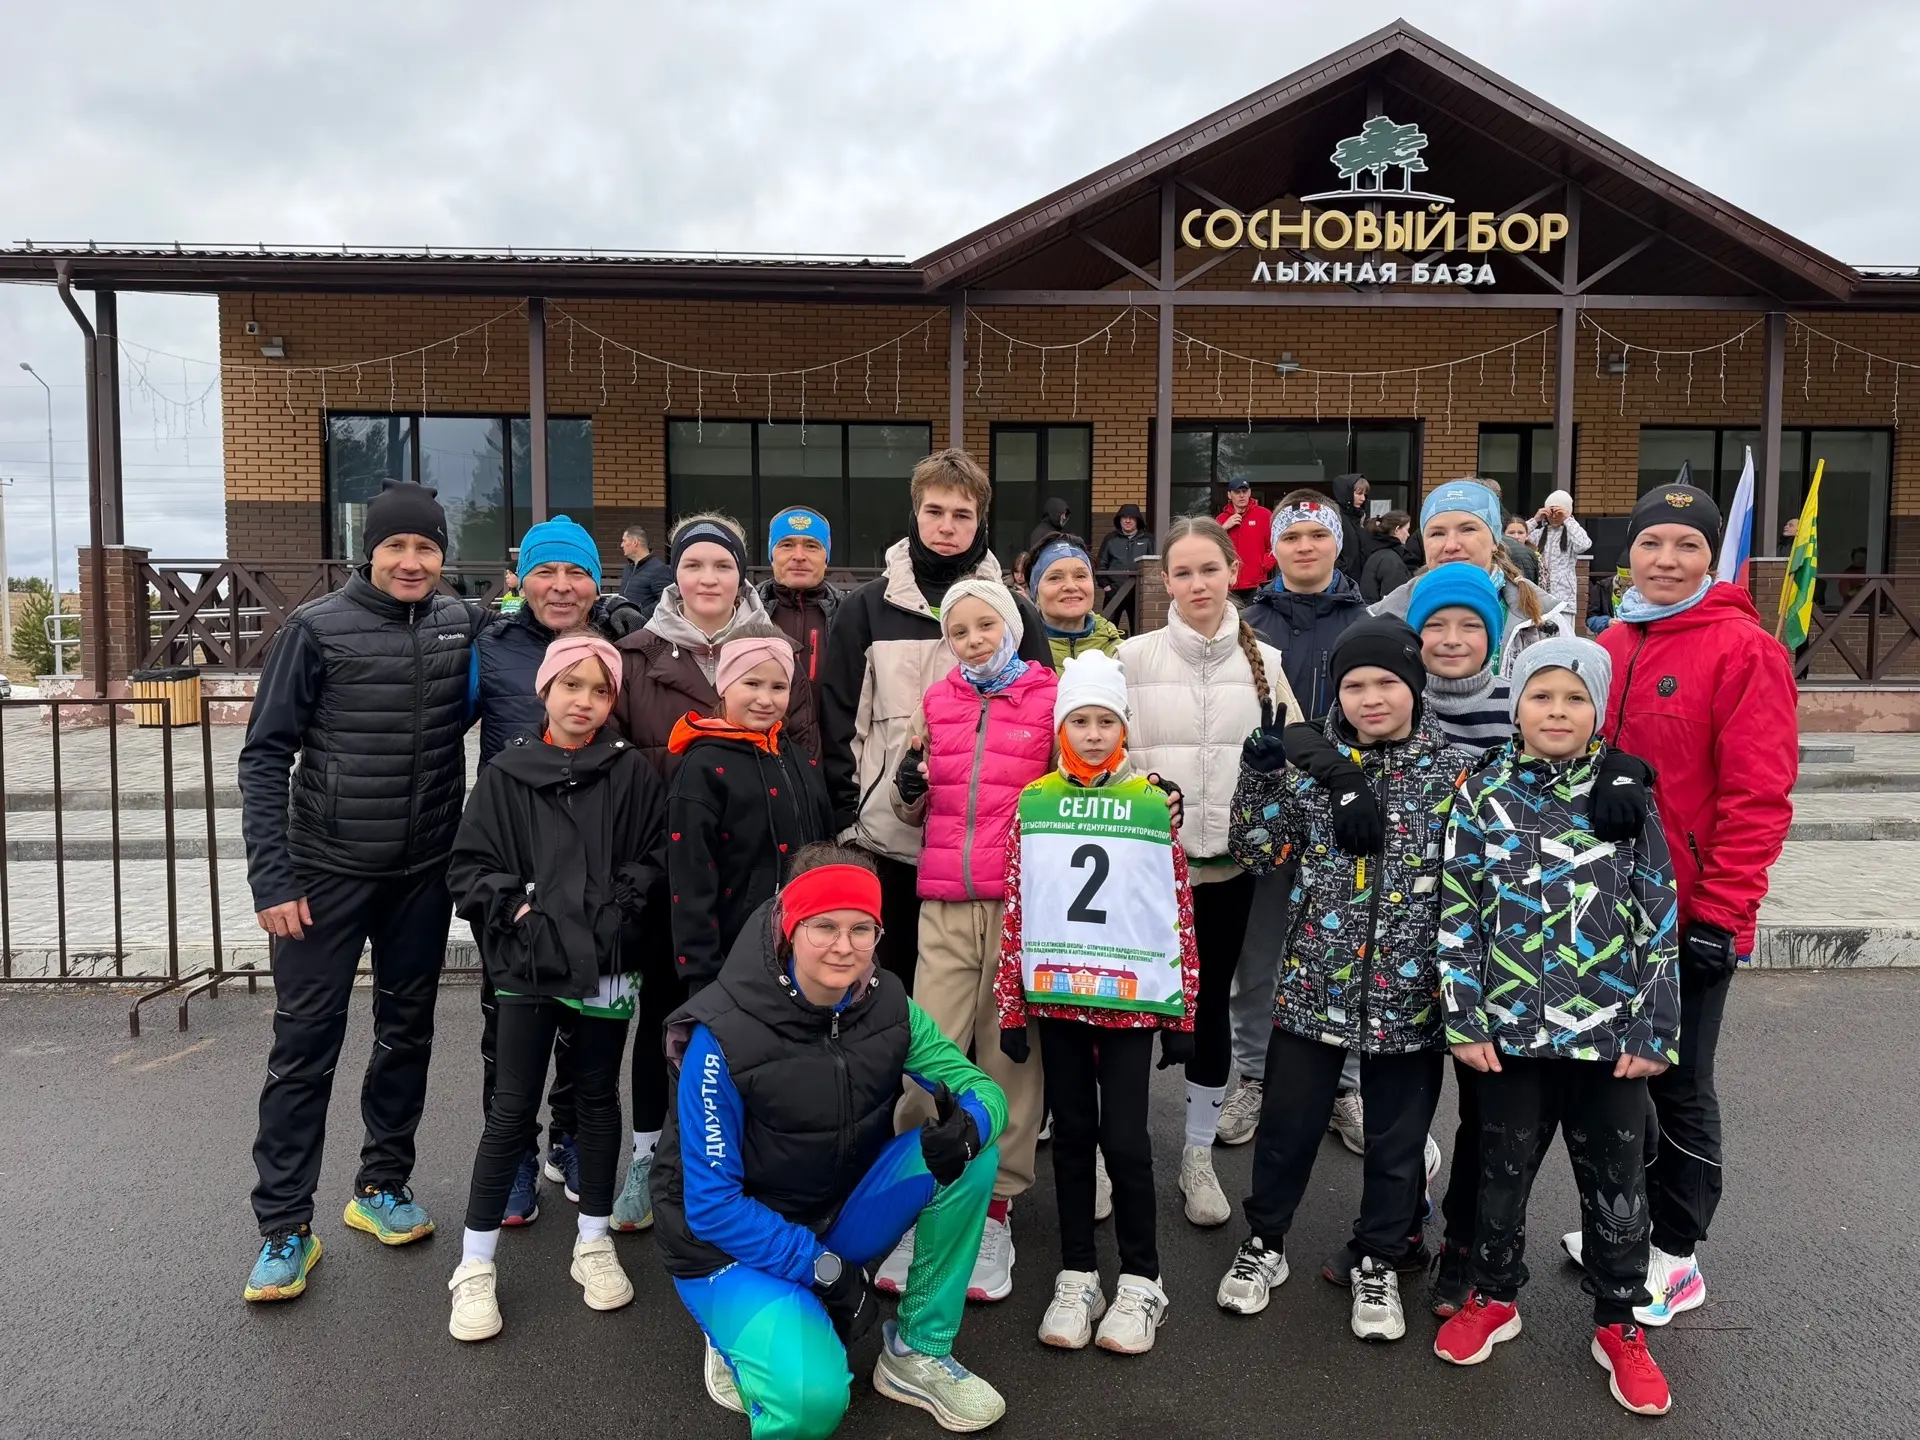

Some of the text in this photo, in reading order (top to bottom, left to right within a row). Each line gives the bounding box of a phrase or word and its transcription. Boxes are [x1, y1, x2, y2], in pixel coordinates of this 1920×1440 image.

[1181, 203, 1569, 254] СОСНОВЫЙ БОР
[1251, 261, 1497, 285] ЛЫЖНАЯ БАЗА
[1058, 796, 1132, 821] СЕЛТЫ
[1021, 821, 1076, 830] ЕЛТЫСПОРТИВНЫЕ
[1067, 843, 1110, 925] 2
